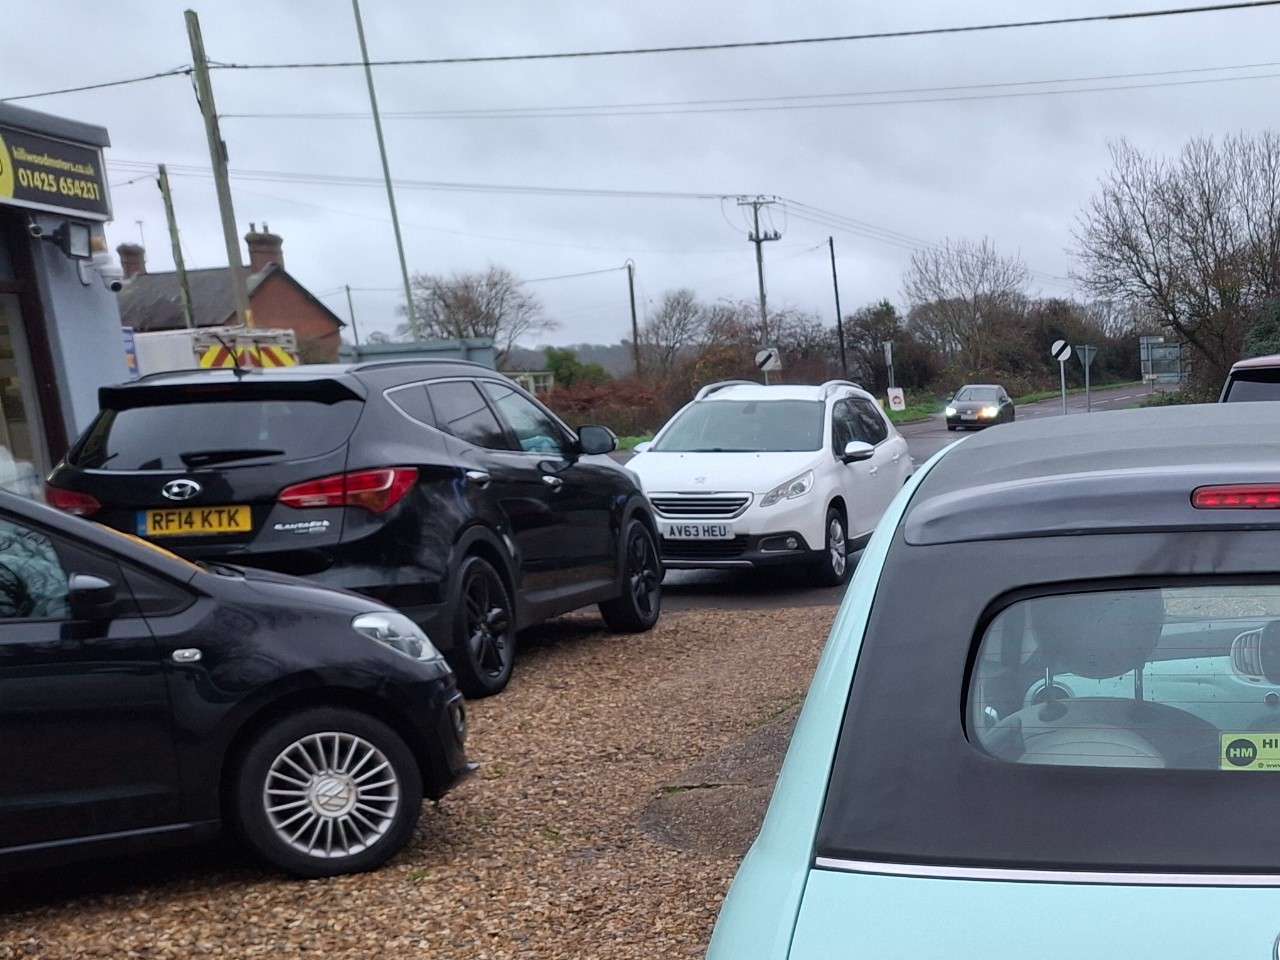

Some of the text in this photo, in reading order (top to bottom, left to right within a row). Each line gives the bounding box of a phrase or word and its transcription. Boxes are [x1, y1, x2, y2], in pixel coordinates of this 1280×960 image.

[18, 167, 99, 201] 01425 654231
[152, 508, 240, 531] RF14 KTK
[669, 525, 727, 537] AV63 HEU
[1229, 747, 1254, 758] HM
